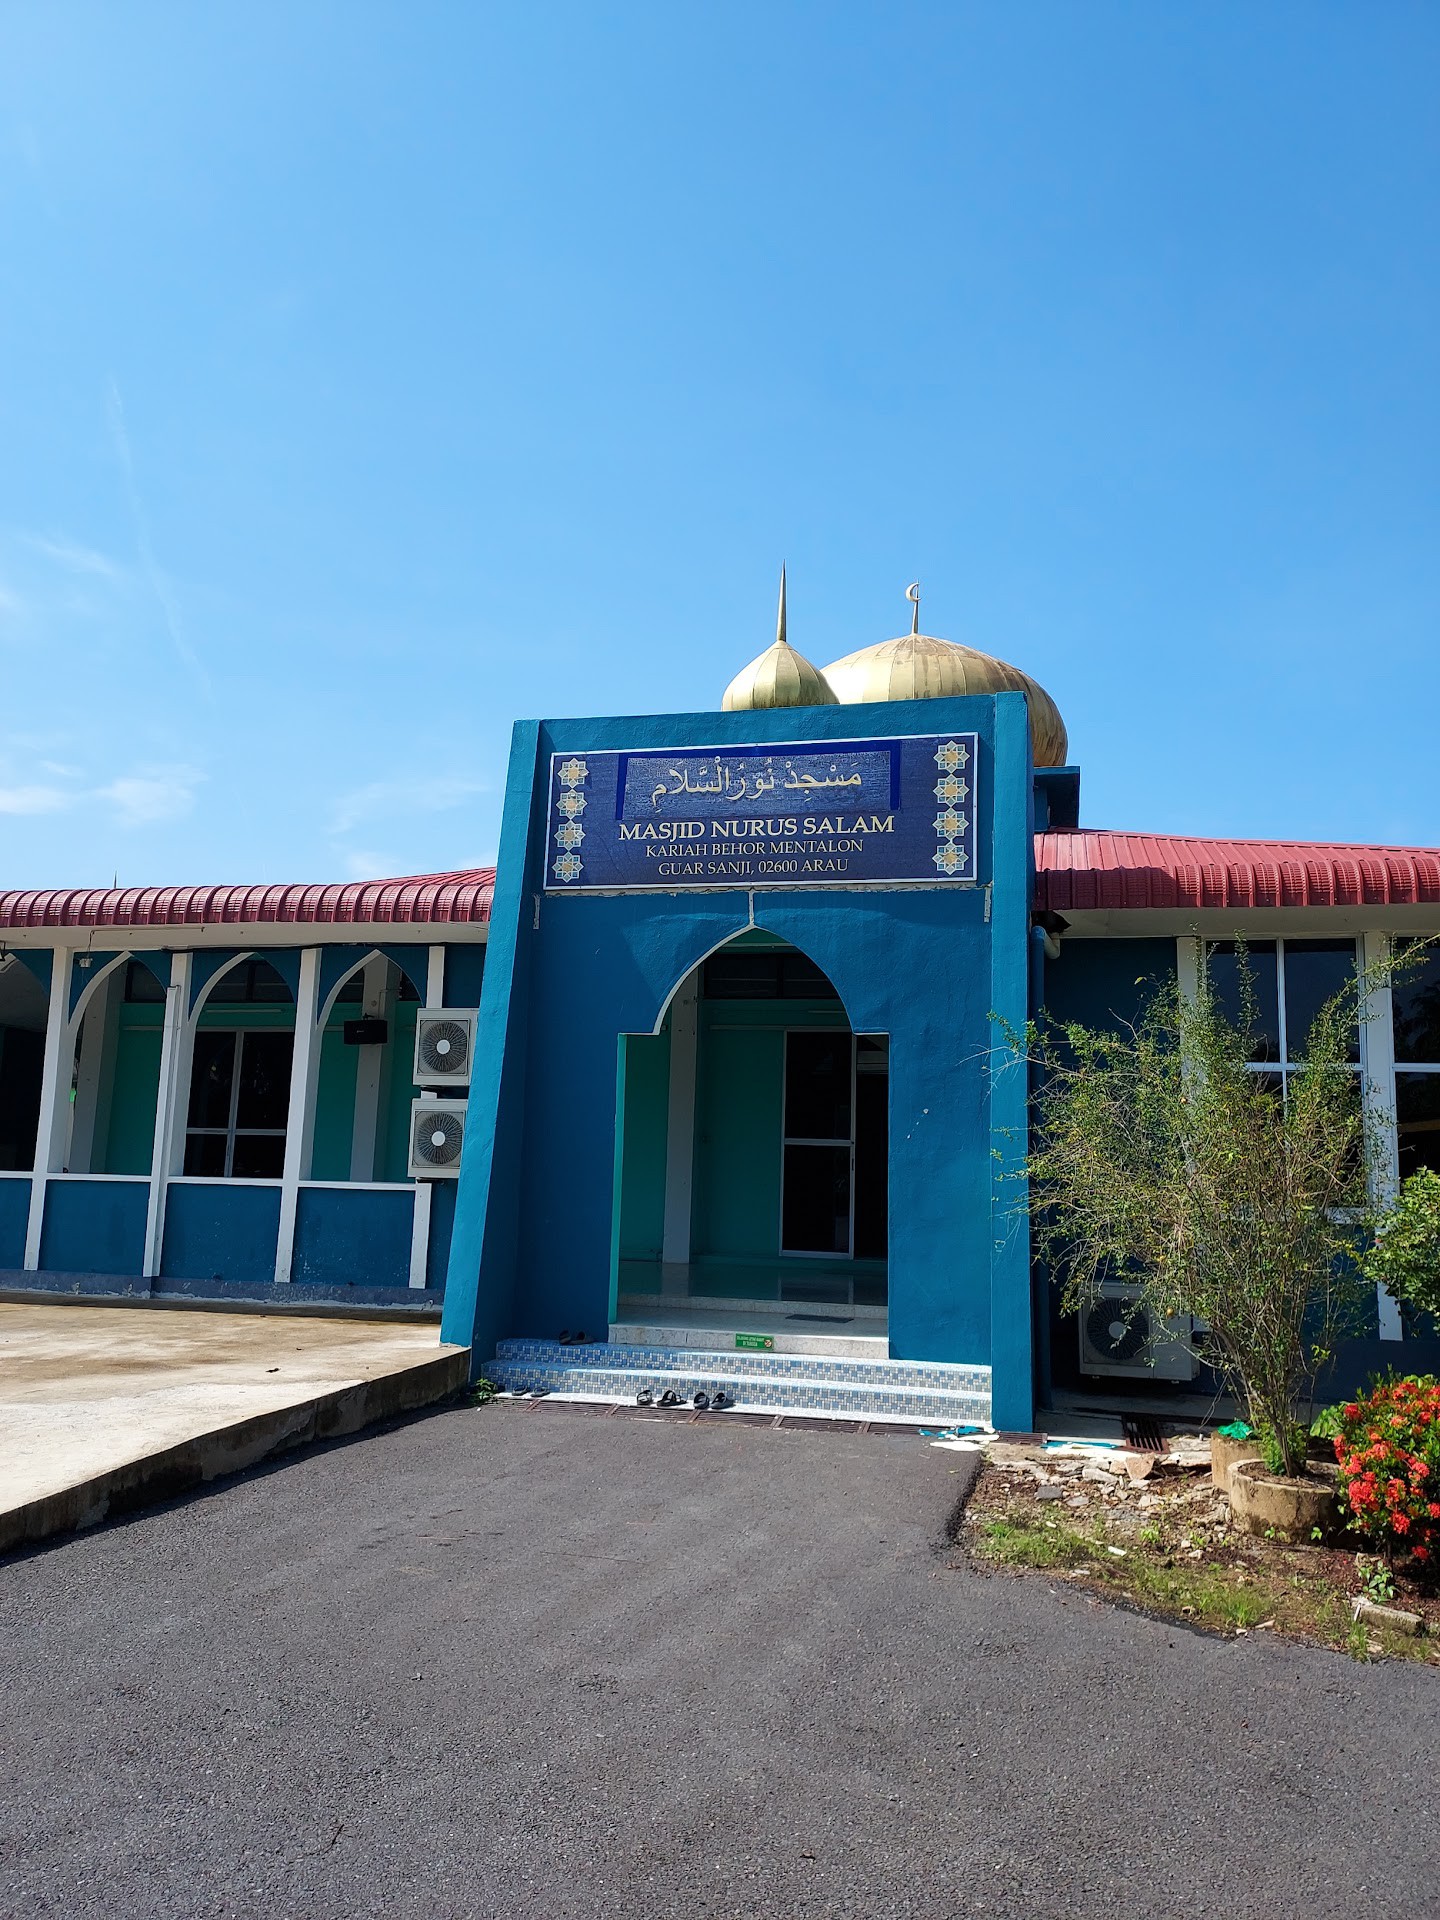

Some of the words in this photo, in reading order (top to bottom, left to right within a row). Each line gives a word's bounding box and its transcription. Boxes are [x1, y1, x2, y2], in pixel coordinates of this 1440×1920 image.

[618, 822, 705, 842] MASJID
[711, 818, 798, 838] NURUS
[803, 815, 895, 835] SALAM
[645, 843, 708, 857] KARIAH
[712, 842, 765, 856] BEHOR
[770, 839, 864, 854] MENTALON
[658, 862, 704, 875] GUAR
[708, 861, 754, 876] SANJI,
[758, 860, 798, 873] 02600
[801, 859, 848, 872] ARAU
